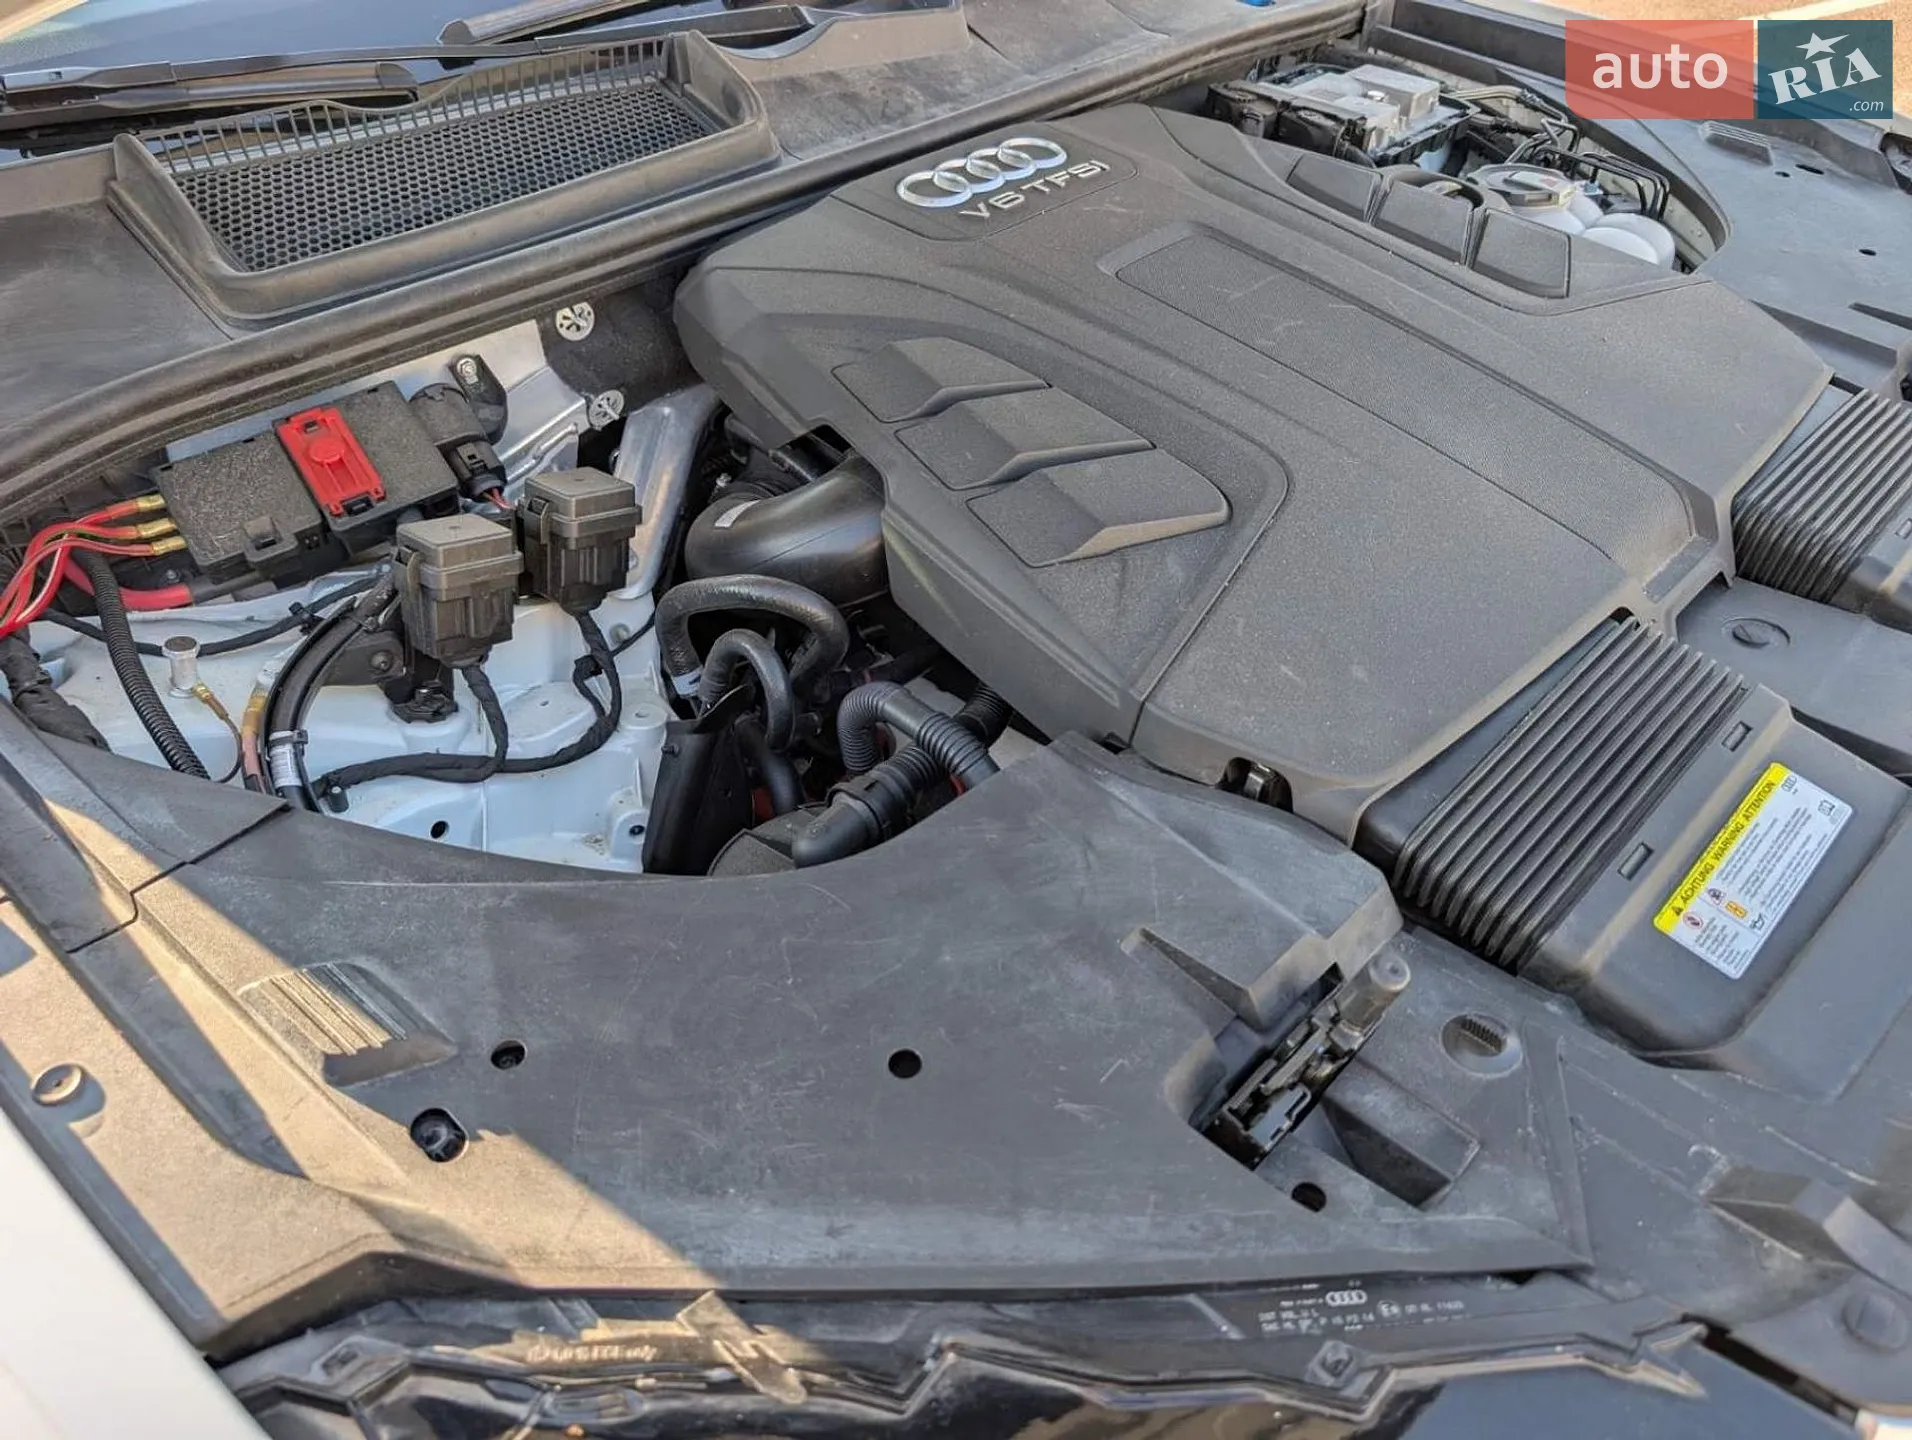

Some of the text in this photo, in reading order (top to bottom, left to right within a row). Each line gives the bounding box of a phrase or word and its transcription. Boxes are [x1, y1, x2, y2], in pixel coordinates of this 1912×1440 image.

[958, 191, 1025, 220] V6
[1680, 862, 1716, 905] ACHTUNG
[1712, 821, 1745, 862] WARNING
[1742, 779, 1776, 822] ATTENTION
